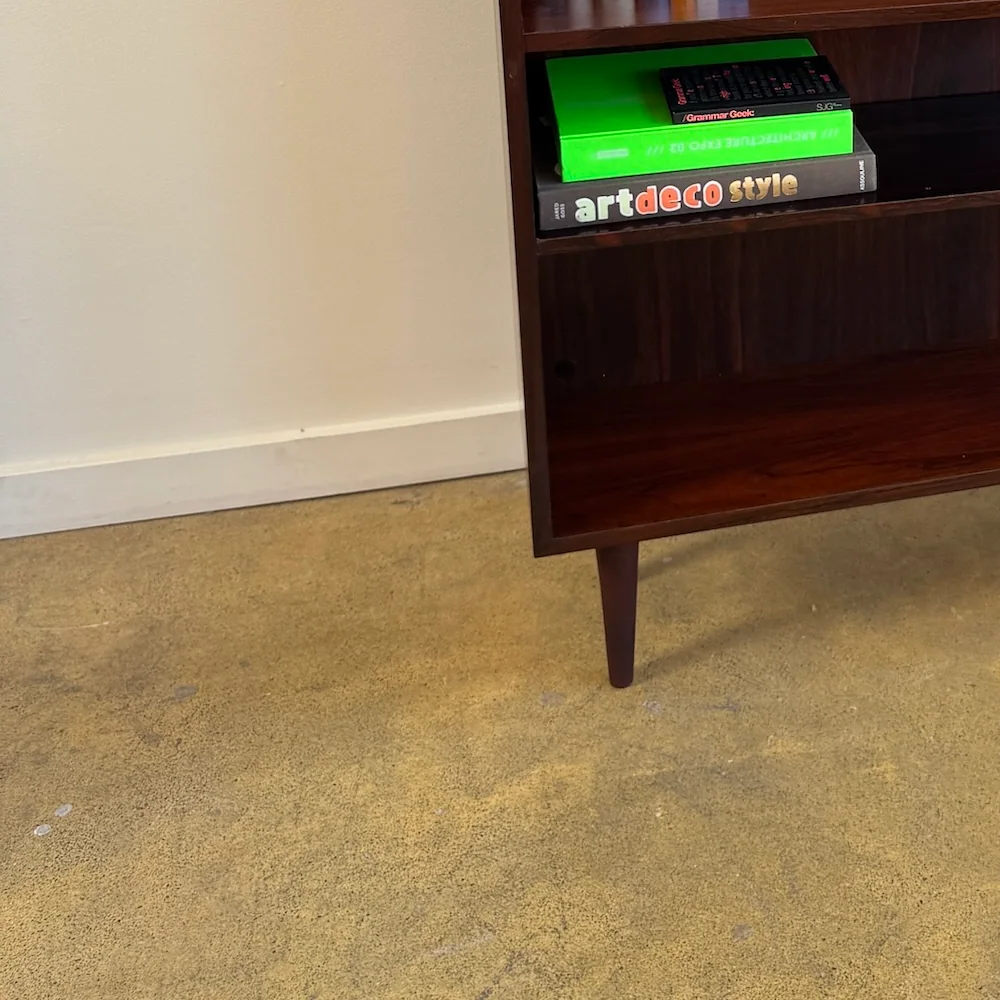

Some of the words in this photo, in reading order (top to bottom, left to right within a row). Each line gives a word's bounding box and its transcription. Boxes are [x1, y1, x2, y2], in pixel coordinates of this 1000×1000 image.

[816, 102, 834, 111] SJG
[730, 109, 754, 118] Geek
[729, 172, 798, 203] style
